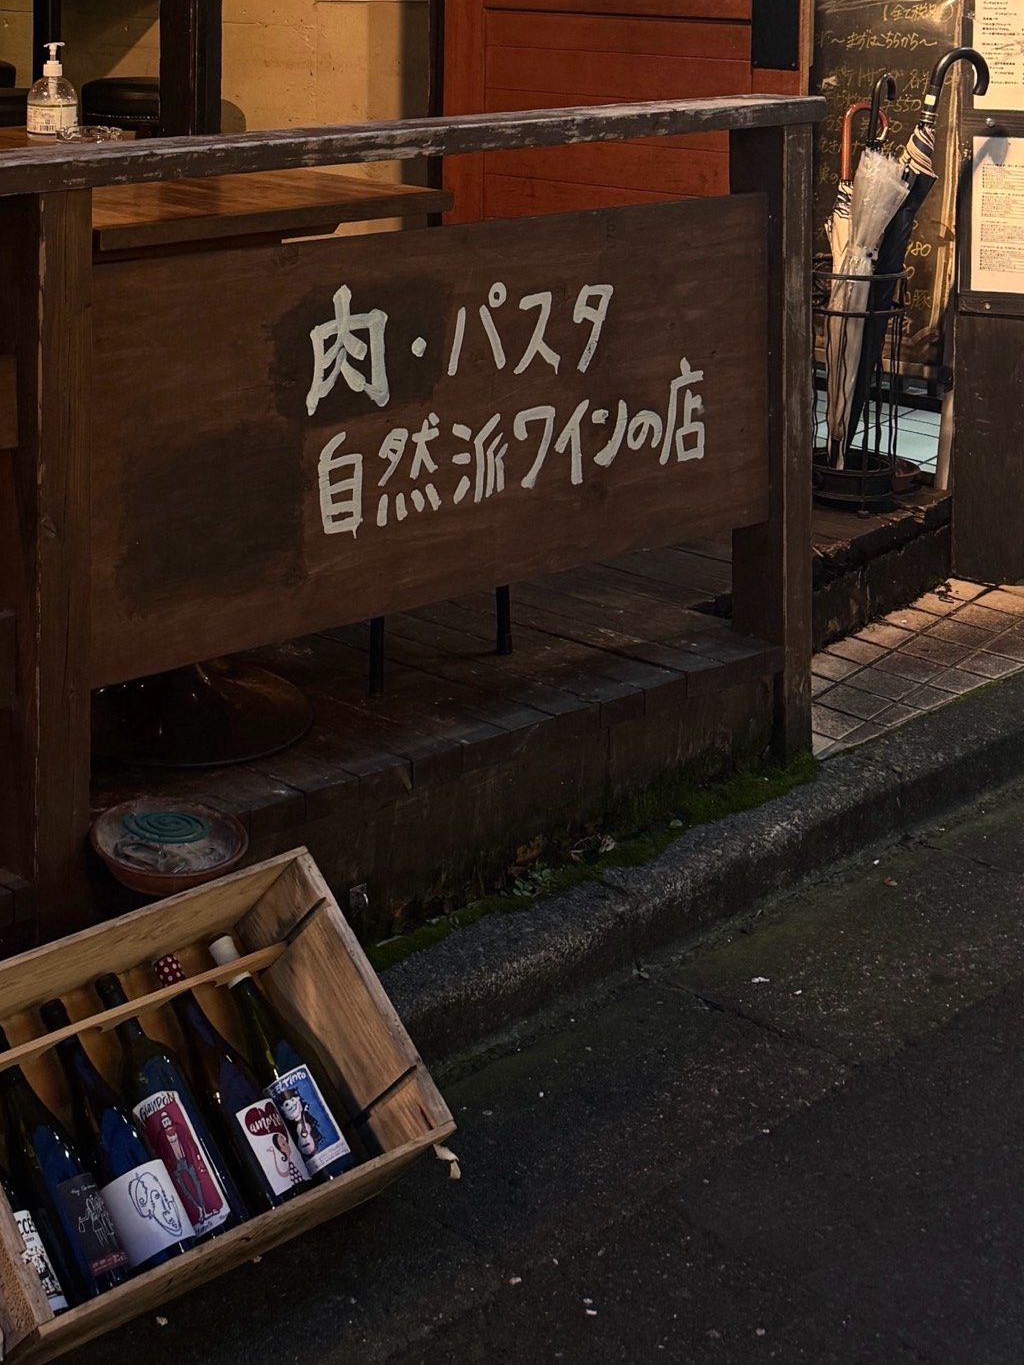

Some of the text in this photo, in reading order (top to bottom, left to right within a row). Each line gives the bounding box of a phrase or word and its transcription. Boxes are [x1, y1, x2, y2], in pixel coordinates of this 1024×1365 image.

[306, 282, 614, 417] 肉・パスタ
[317, 356, 705, 540] 自然派ワインの店
